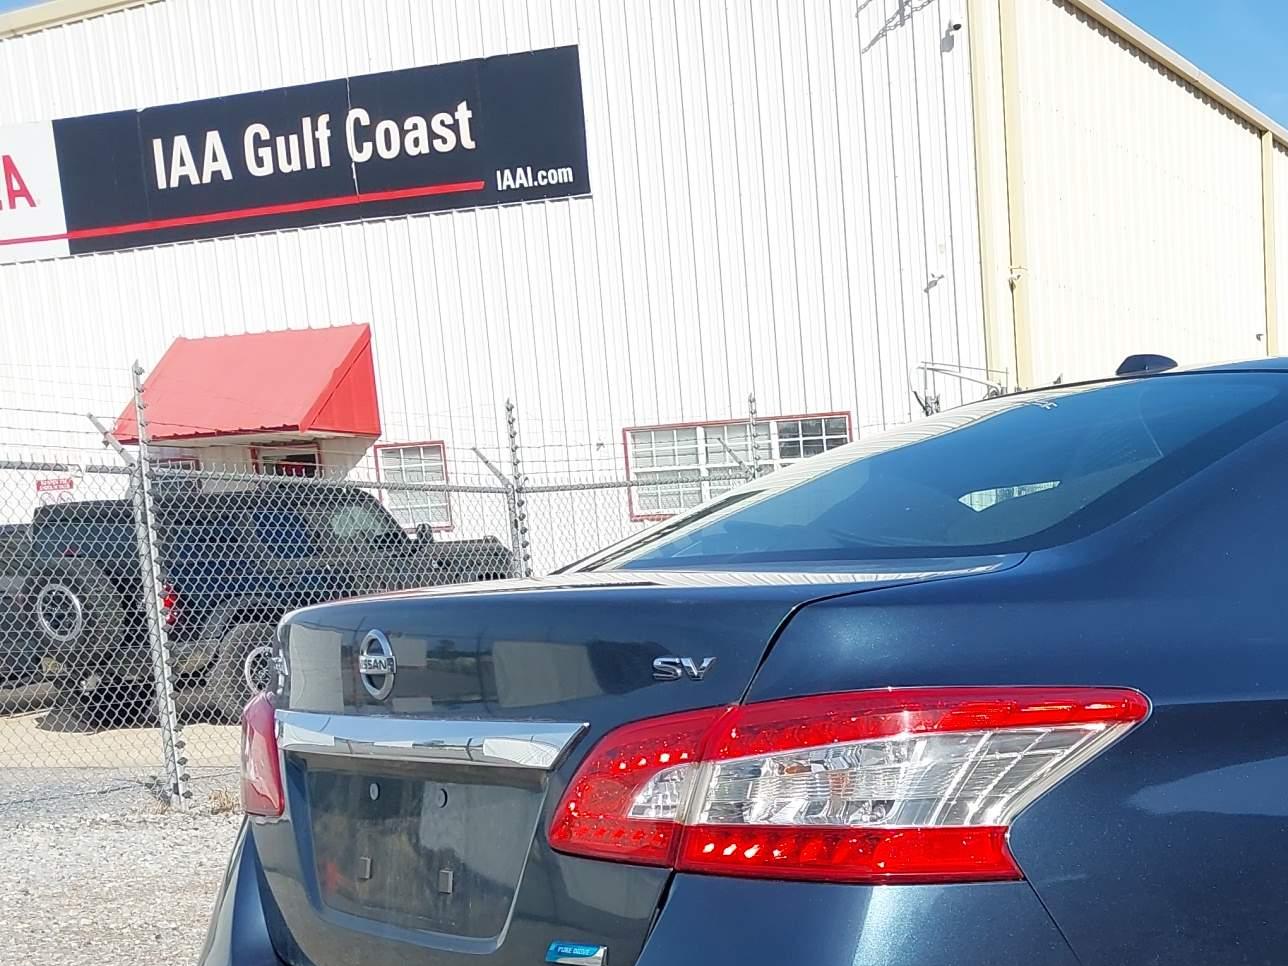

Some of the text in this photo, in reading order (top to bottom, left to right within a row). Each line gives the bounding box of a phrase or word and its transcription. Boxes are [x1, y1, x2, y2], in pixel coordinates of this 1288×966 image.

[152, 100, 476, 190] IAA Gulf Coast
[0, 154, 37, 210] A
[496, 166, 573, 191] IAAI.com
[653, 657, 718, 681] SV
